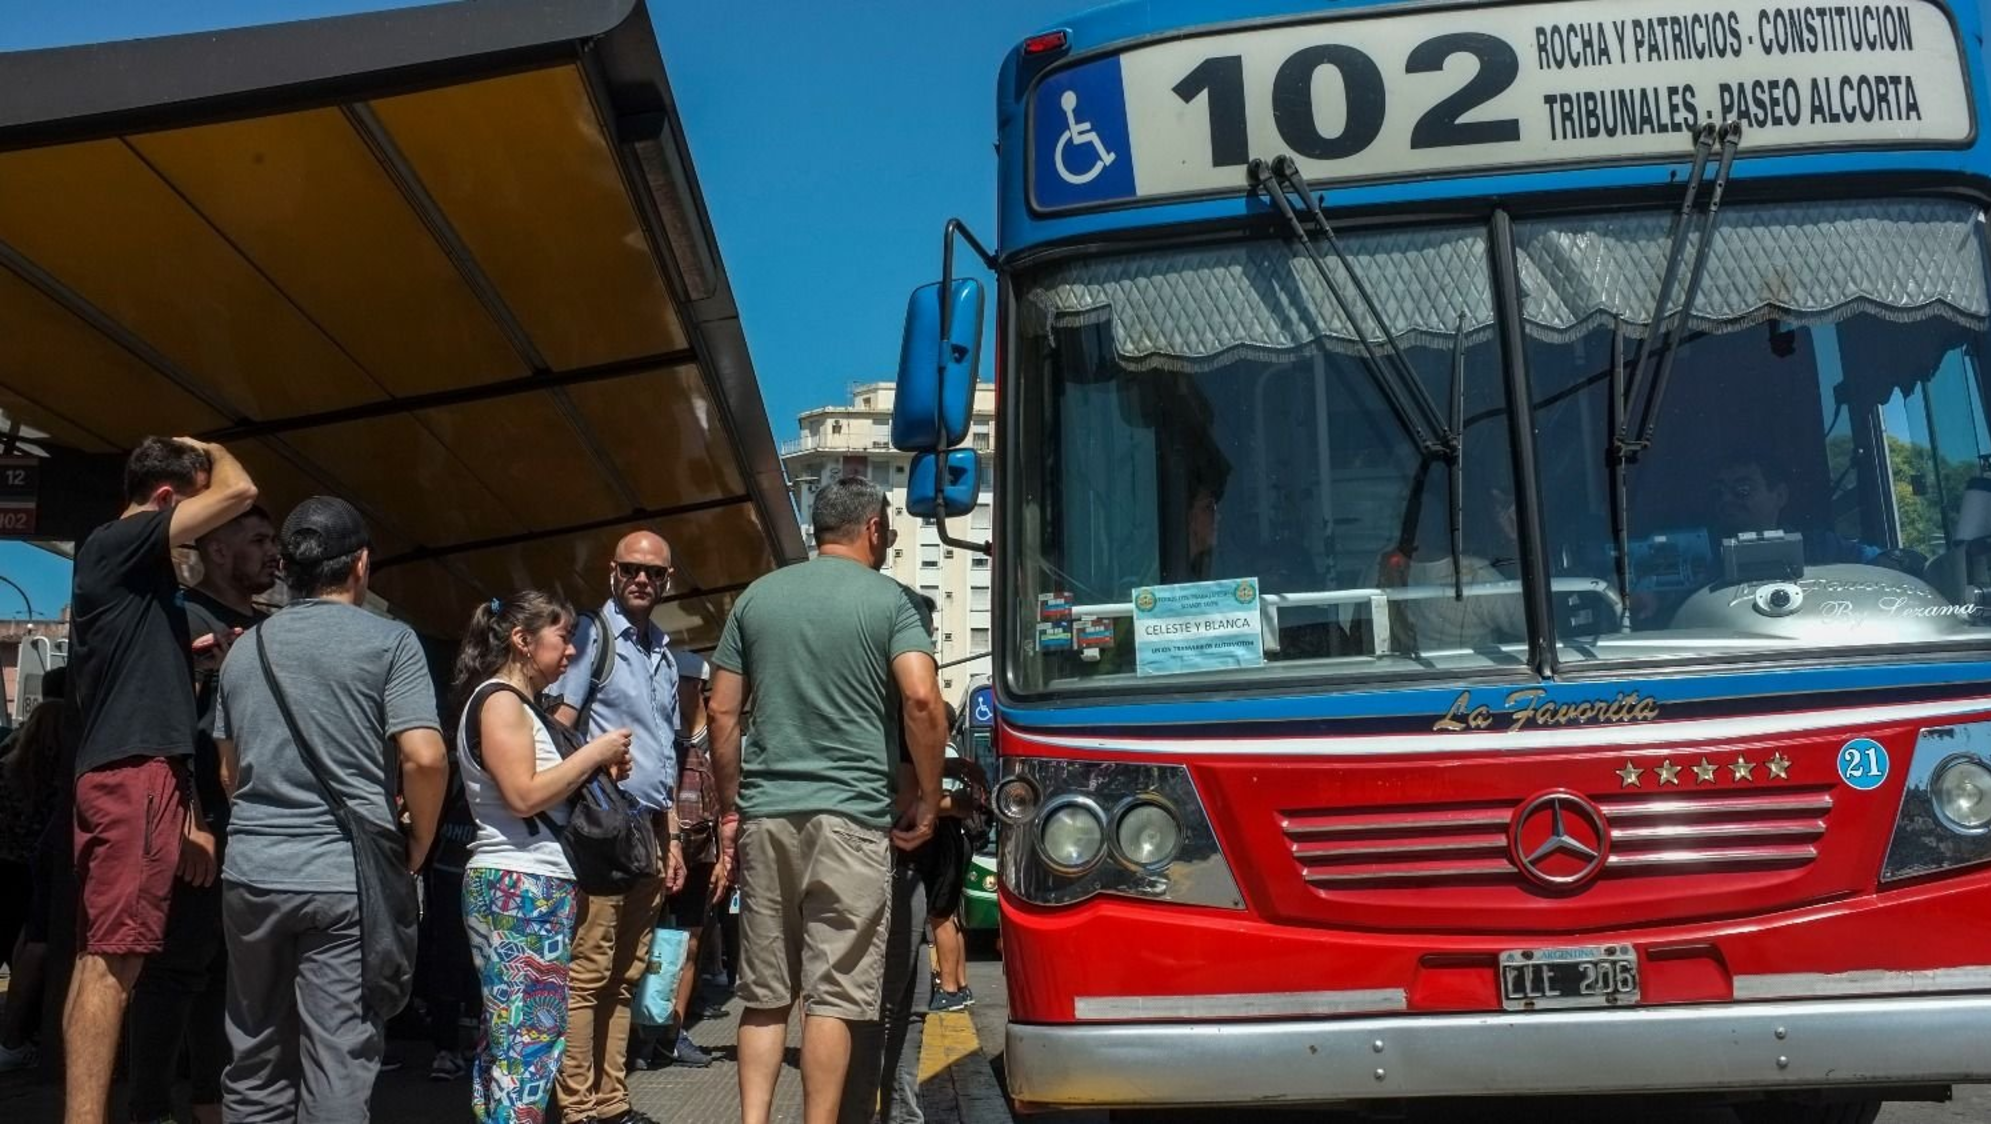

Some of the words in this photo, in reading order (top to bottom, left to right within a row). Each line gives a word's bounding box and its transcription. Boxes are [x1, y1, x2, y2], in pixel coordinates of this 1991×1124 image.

[1535, 22, 1612, 70] ROCHA
[1612, 20, 1626, 64] Y
[1632, 11, 1742, 63] PATRICIOS
[1758, 5, 1914, 55] CONSTITUCION
[1171, 32, 1521, 168] 102
[1543, 83, 1698, 141] TRIBUNALES
[1719, 77, 1801, 128] PASEO
[1810, 74, 1922, 124] ALCORTA
[6, 470, 26, 485] 12
[1878, 596, 1983, 617] Lezama
[1145, 622, 1192, 636] CELESTE
[1194, 621, 1201, 632] Y
[1204, 618, 1251, 632] BLANCA
[1432, 690, 1493, 731] La
[1505, 688, 1660, 734] Favorita
[1844, 747, 1882, 778] 21
[1541, 948, 1595, 960] ARGENTINA
[1578, 961, 1636, 994] 206
